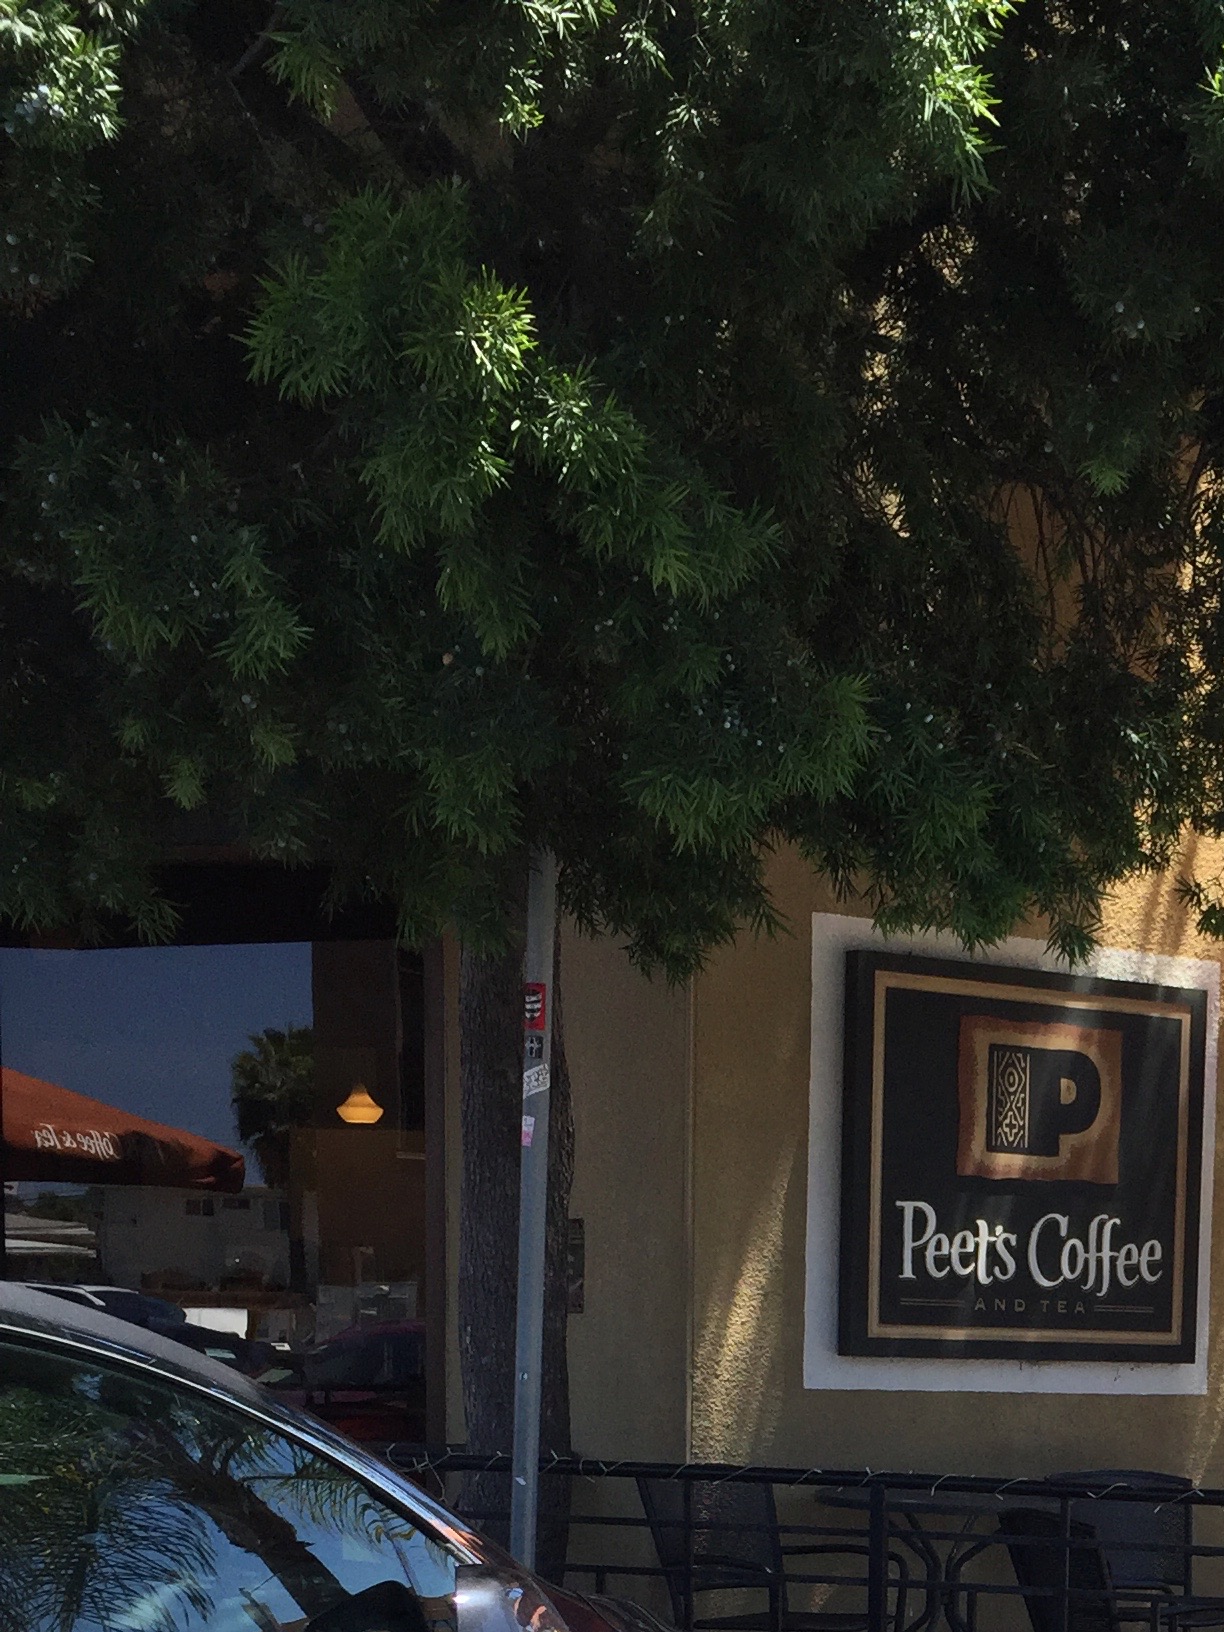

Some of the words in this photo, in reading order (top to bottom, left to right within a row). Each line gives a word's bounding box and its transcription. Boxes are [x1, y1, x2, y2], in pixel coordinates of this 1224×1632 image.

[895, 1200, 1017, 1285] Peet's
[1027, 1213, 1163, 1297] Coffee
[974, 1297, 1027, 1312] AND
[1040, 1298, 1086, 1315] TEA
